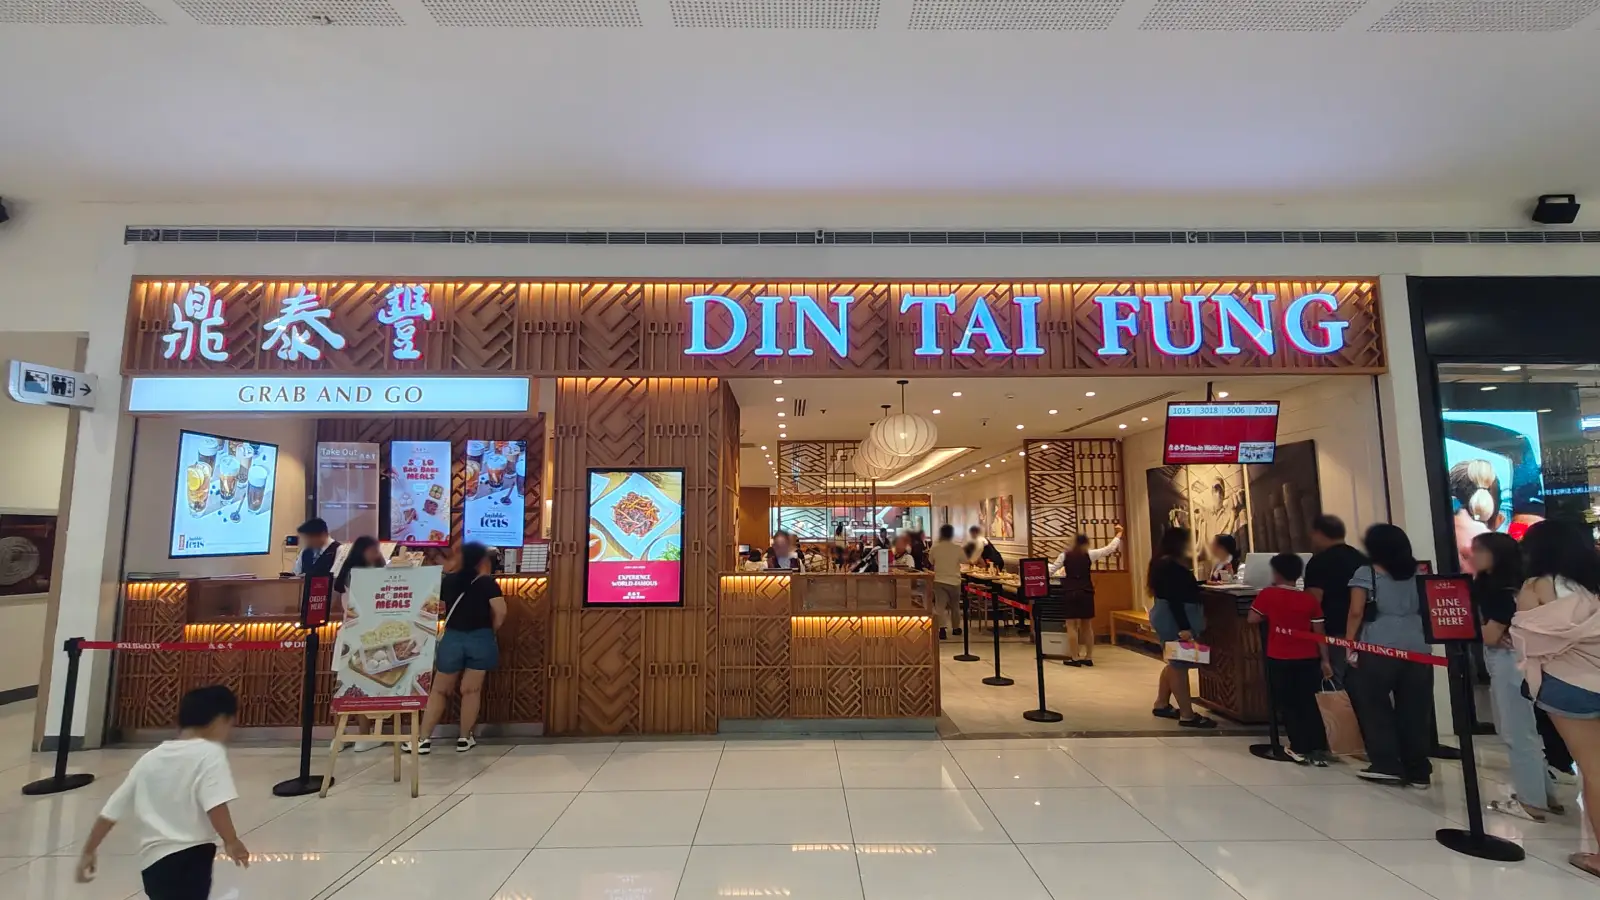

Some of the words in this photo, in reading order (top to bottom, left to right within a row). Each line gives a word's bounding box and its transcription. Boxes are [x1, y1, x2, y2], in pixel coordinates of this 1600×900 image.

[162, 284, 433, 362] 鼎泰豐
[684, 294, 855, 357] DIN
[900, 293, 1046, 357] TAI
[1094, 292, 1350, 356] FUNG
[238, 385, 306, 403] GRAB
[317, 385, 372, 402] AND
[384, 385, 423, 403] GO
[1173, 407, 1191, 415] 1015
[1227, 406, 1245, 414] 5006
[1254, 406, 1272, 414] 7003
[321, 448, 340, 456] Take
[342, 448, 357, 456] Out
[375, 600, 411, 609] MEALS
[1436, 598, 1460, 607] LINE
[1431, 607, 1468, 616] STARTS
[1438, 616, 1464, 626] HERE
[1336, 638, 1351, 648] DIN
[1353, 641, 1366, 651] TAI
[1368, 644, 1394, 657] FUNG
[1395, 649, 1408, 659] PH
